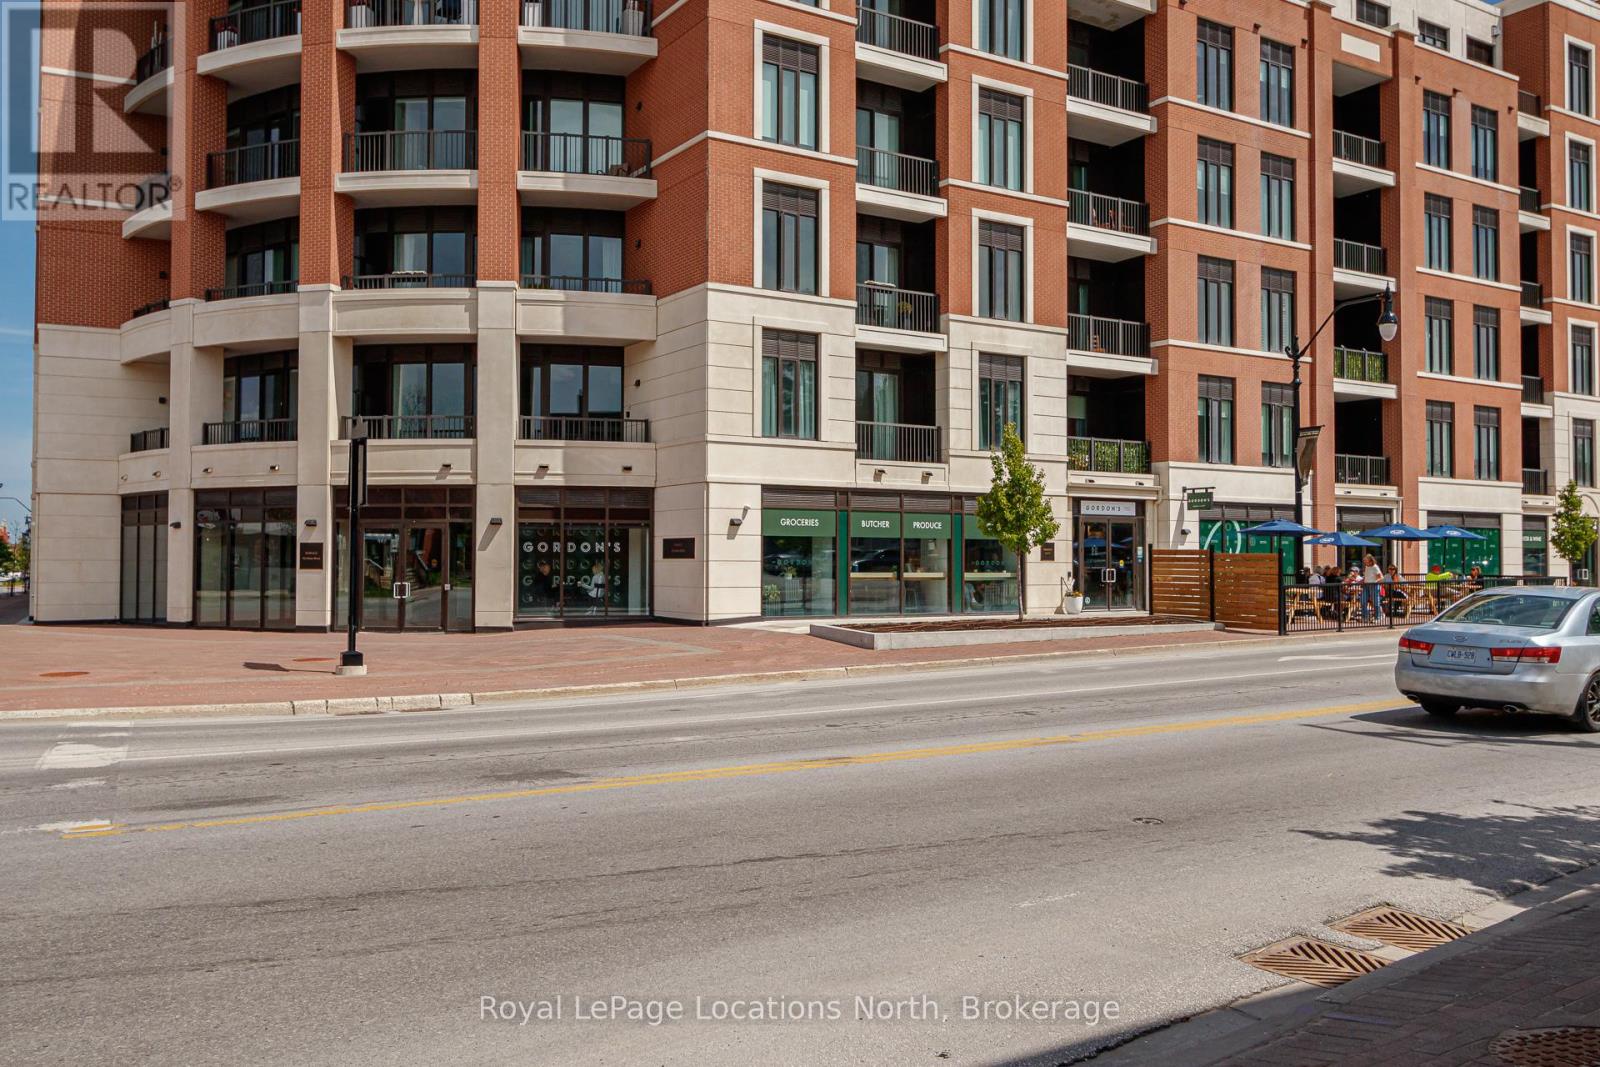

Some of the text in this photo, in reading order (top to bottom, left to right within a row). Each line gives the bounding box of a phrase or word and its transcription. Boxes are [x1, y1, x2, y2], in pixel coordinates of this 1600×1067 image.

[780, 518, 820, 527] GROCERIES
[861, 519, 890, 528] BUTCHER
[912, 521, 942, 530] PRODUCE
[522, 541, 622, 553] GORDON'S
